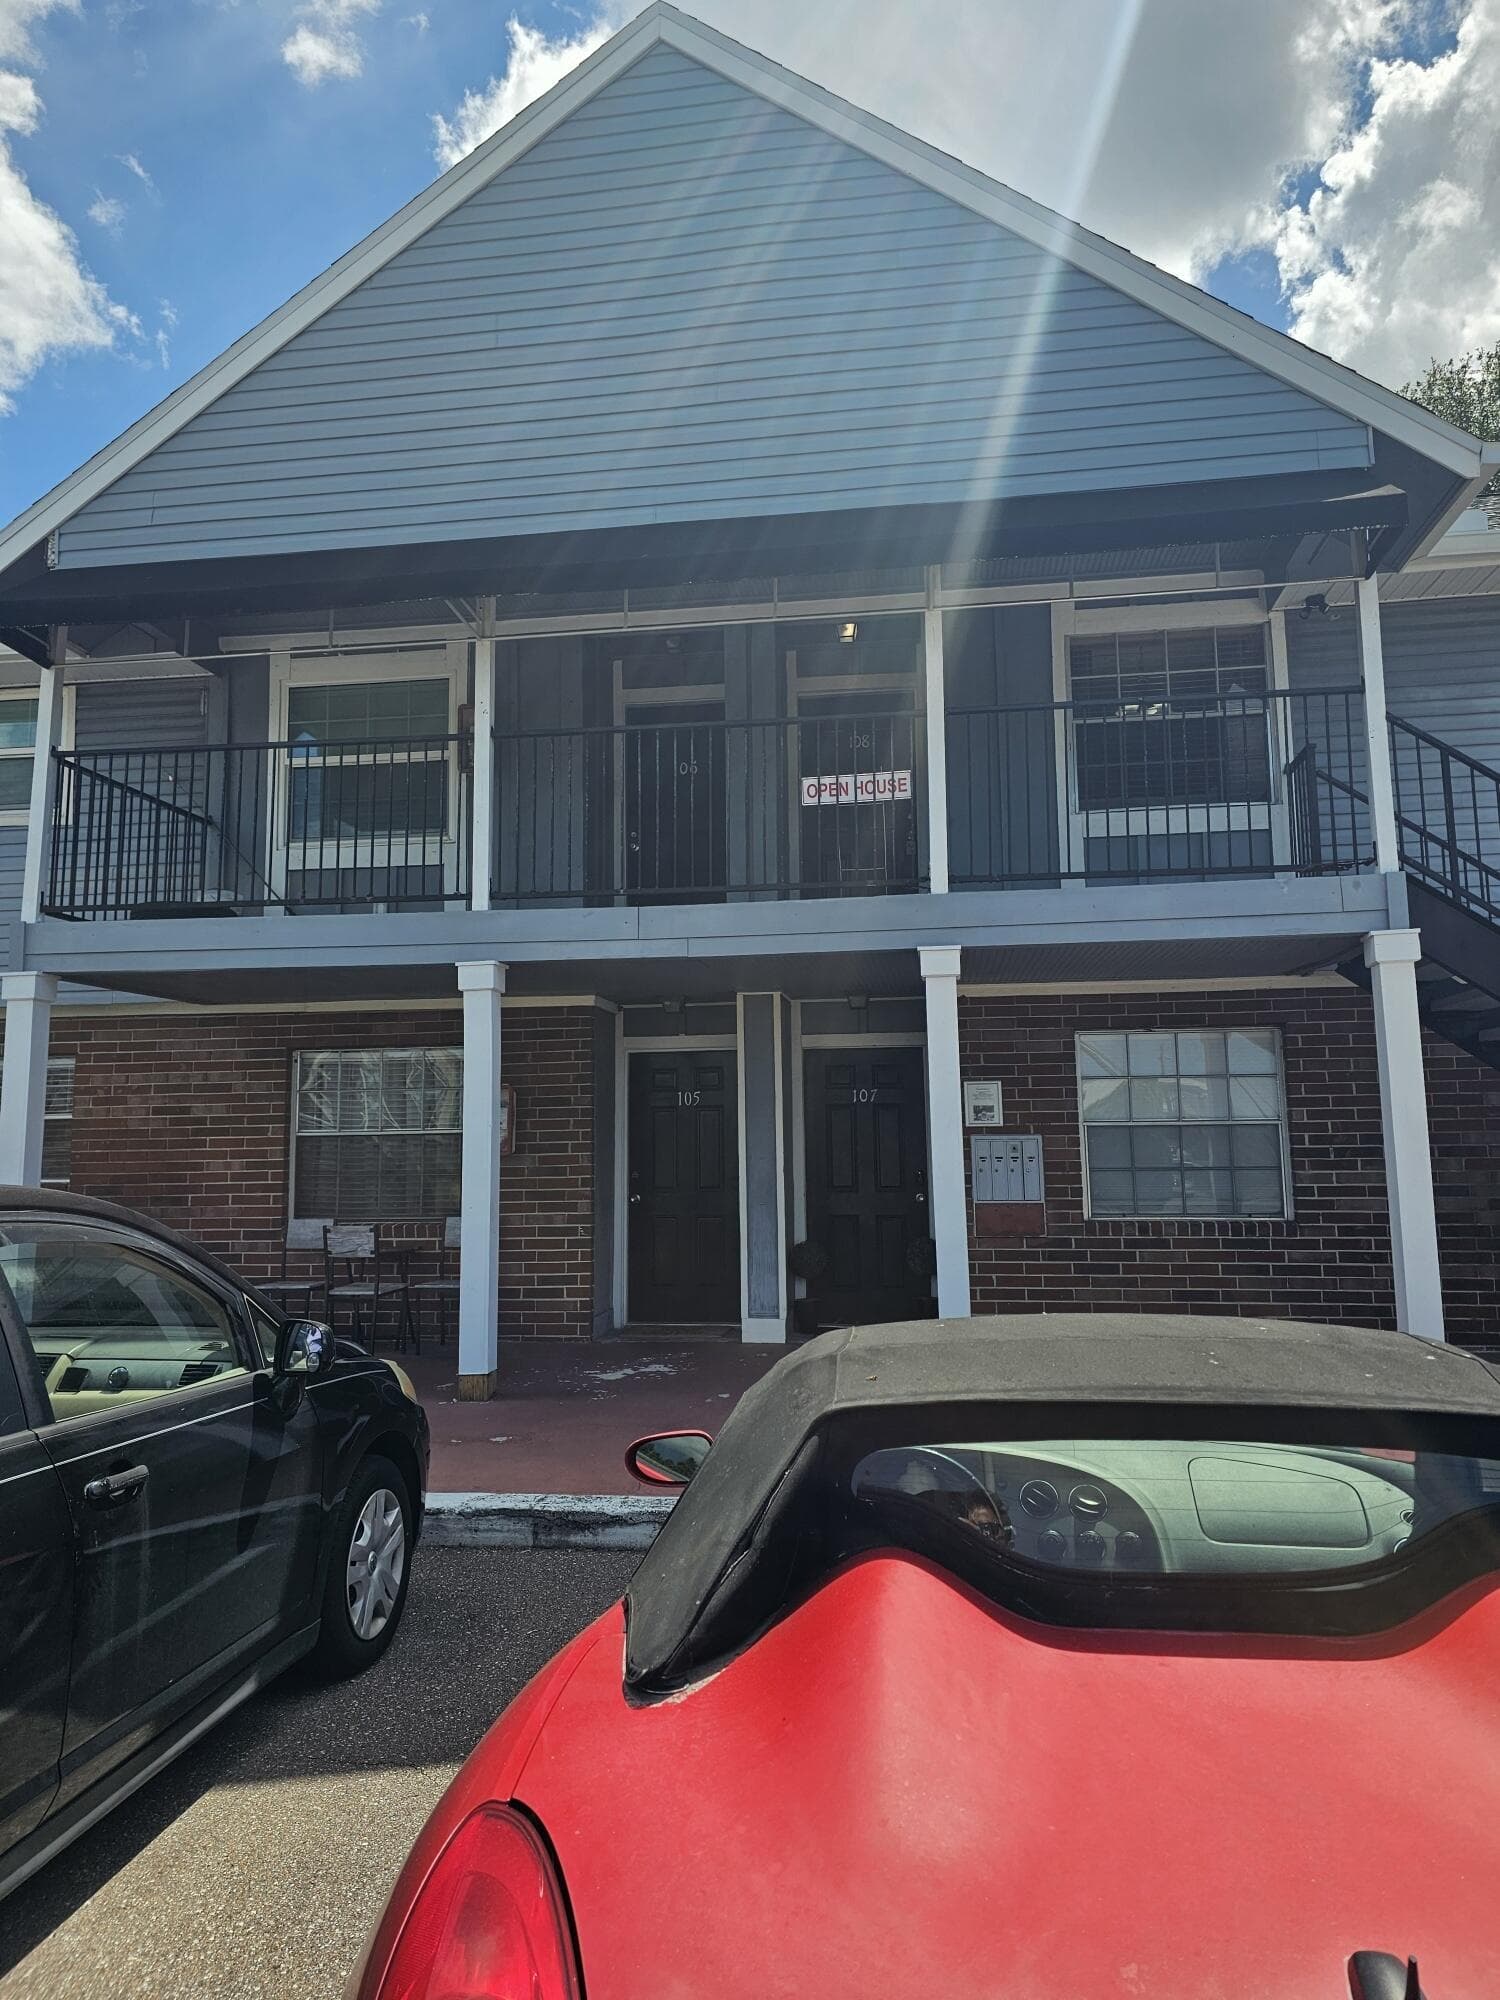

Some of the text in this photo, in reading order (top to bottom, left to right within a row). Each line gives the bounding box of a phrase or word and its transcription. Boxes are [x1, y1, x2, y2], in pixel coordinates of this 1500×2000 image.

[850, 734, 870, 748] 108
[806, 777, 908, 799] OPEN HOUSE
[677, 1091, 701, 1106] 105
[853, 1088, 877, 1103] 107
